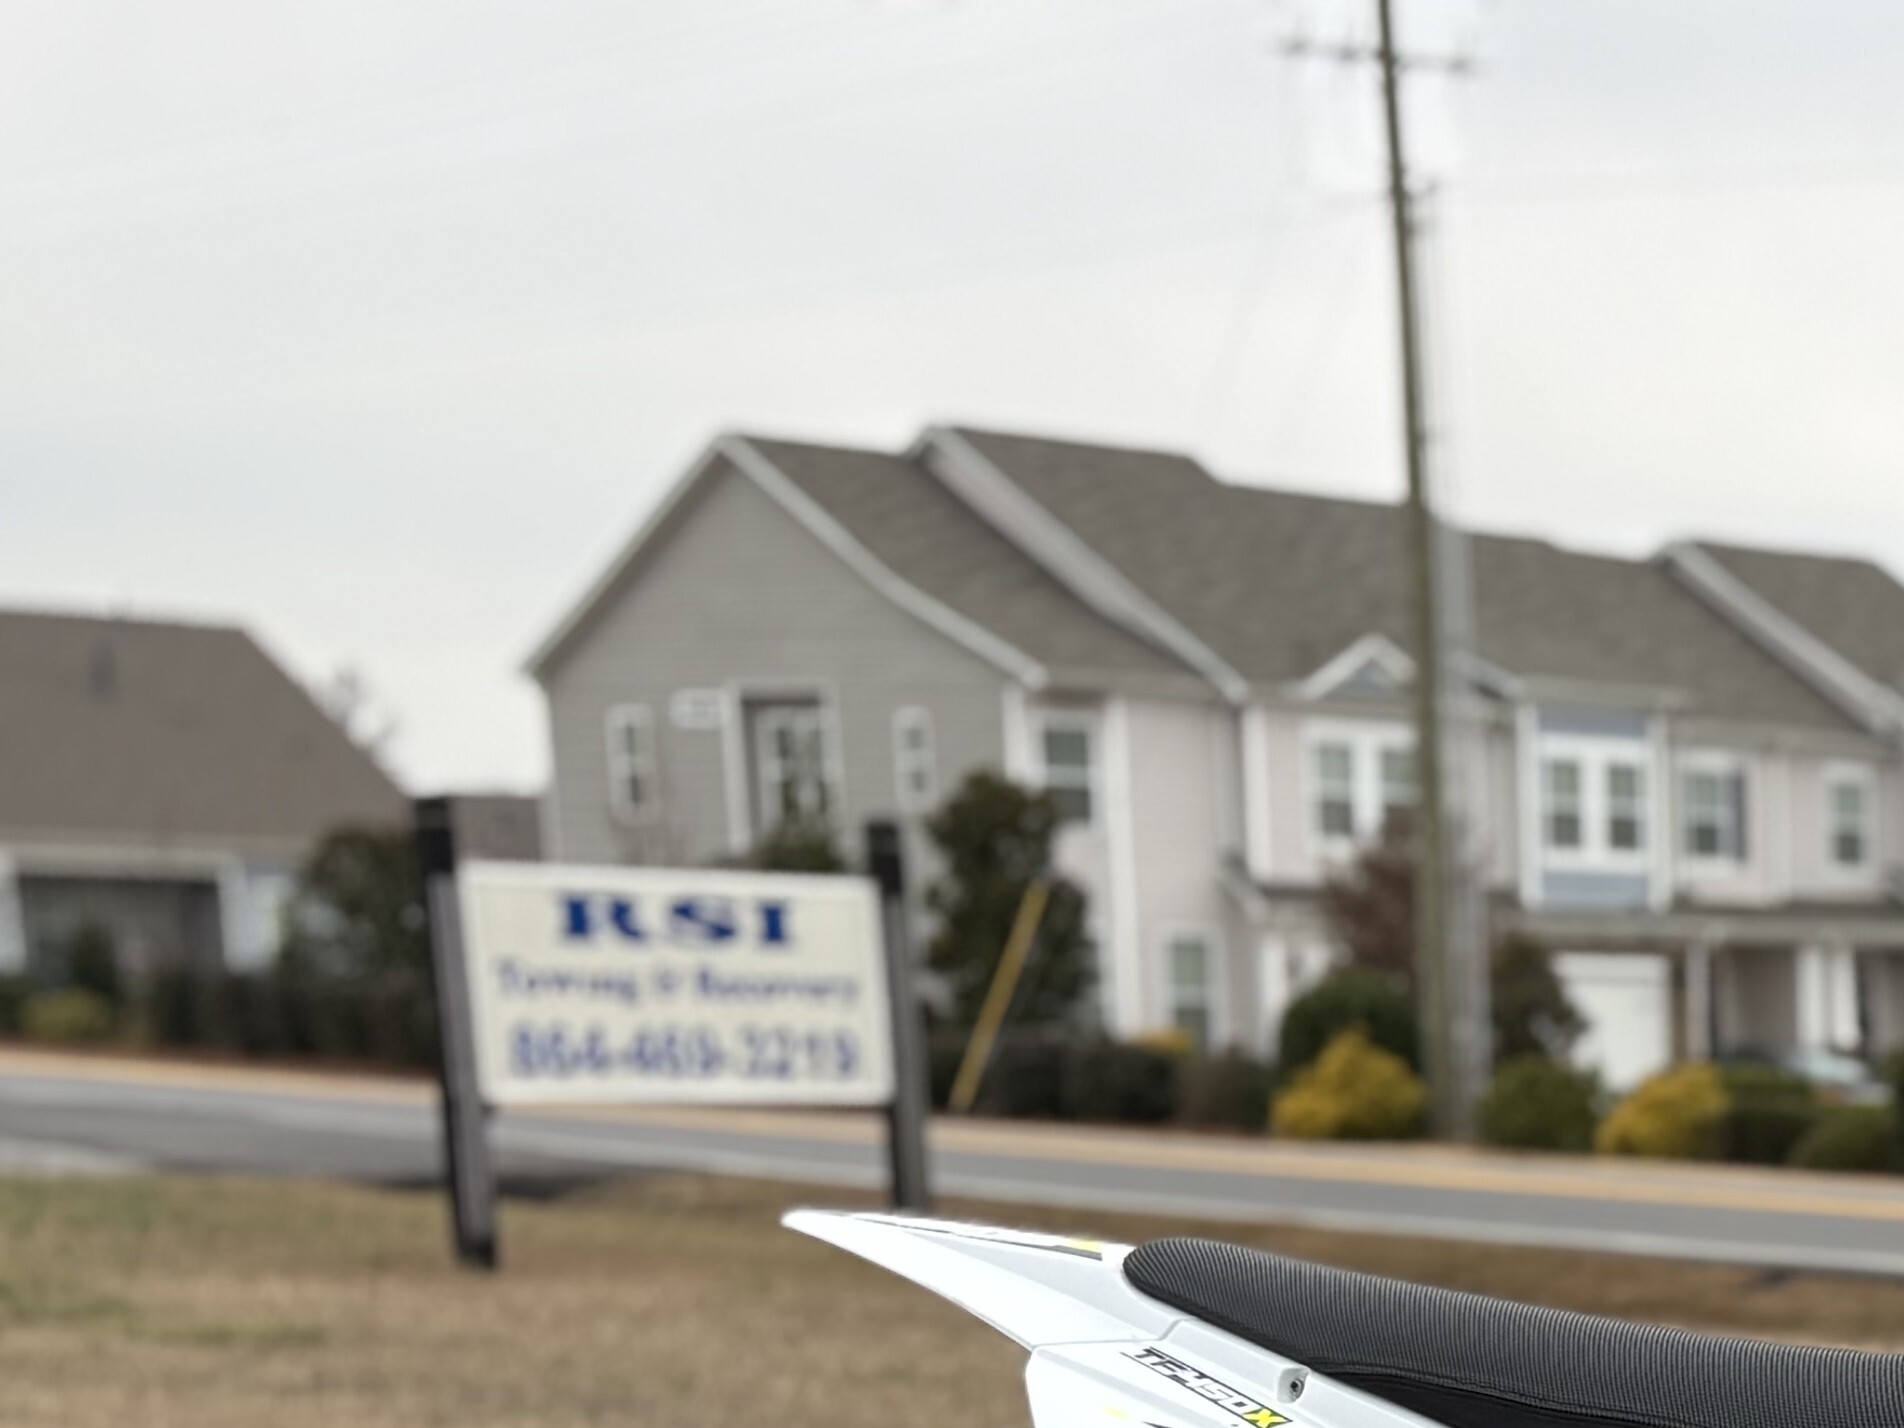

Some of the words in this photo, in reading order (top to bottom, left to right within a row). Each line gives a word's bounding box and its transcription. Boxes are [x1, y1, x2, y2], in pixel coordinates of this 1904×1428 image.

[559, 895, 791, 945] RSI
[495, 959, 638, 1005] Towing
[698, 965, 860, 1000] Recovery
